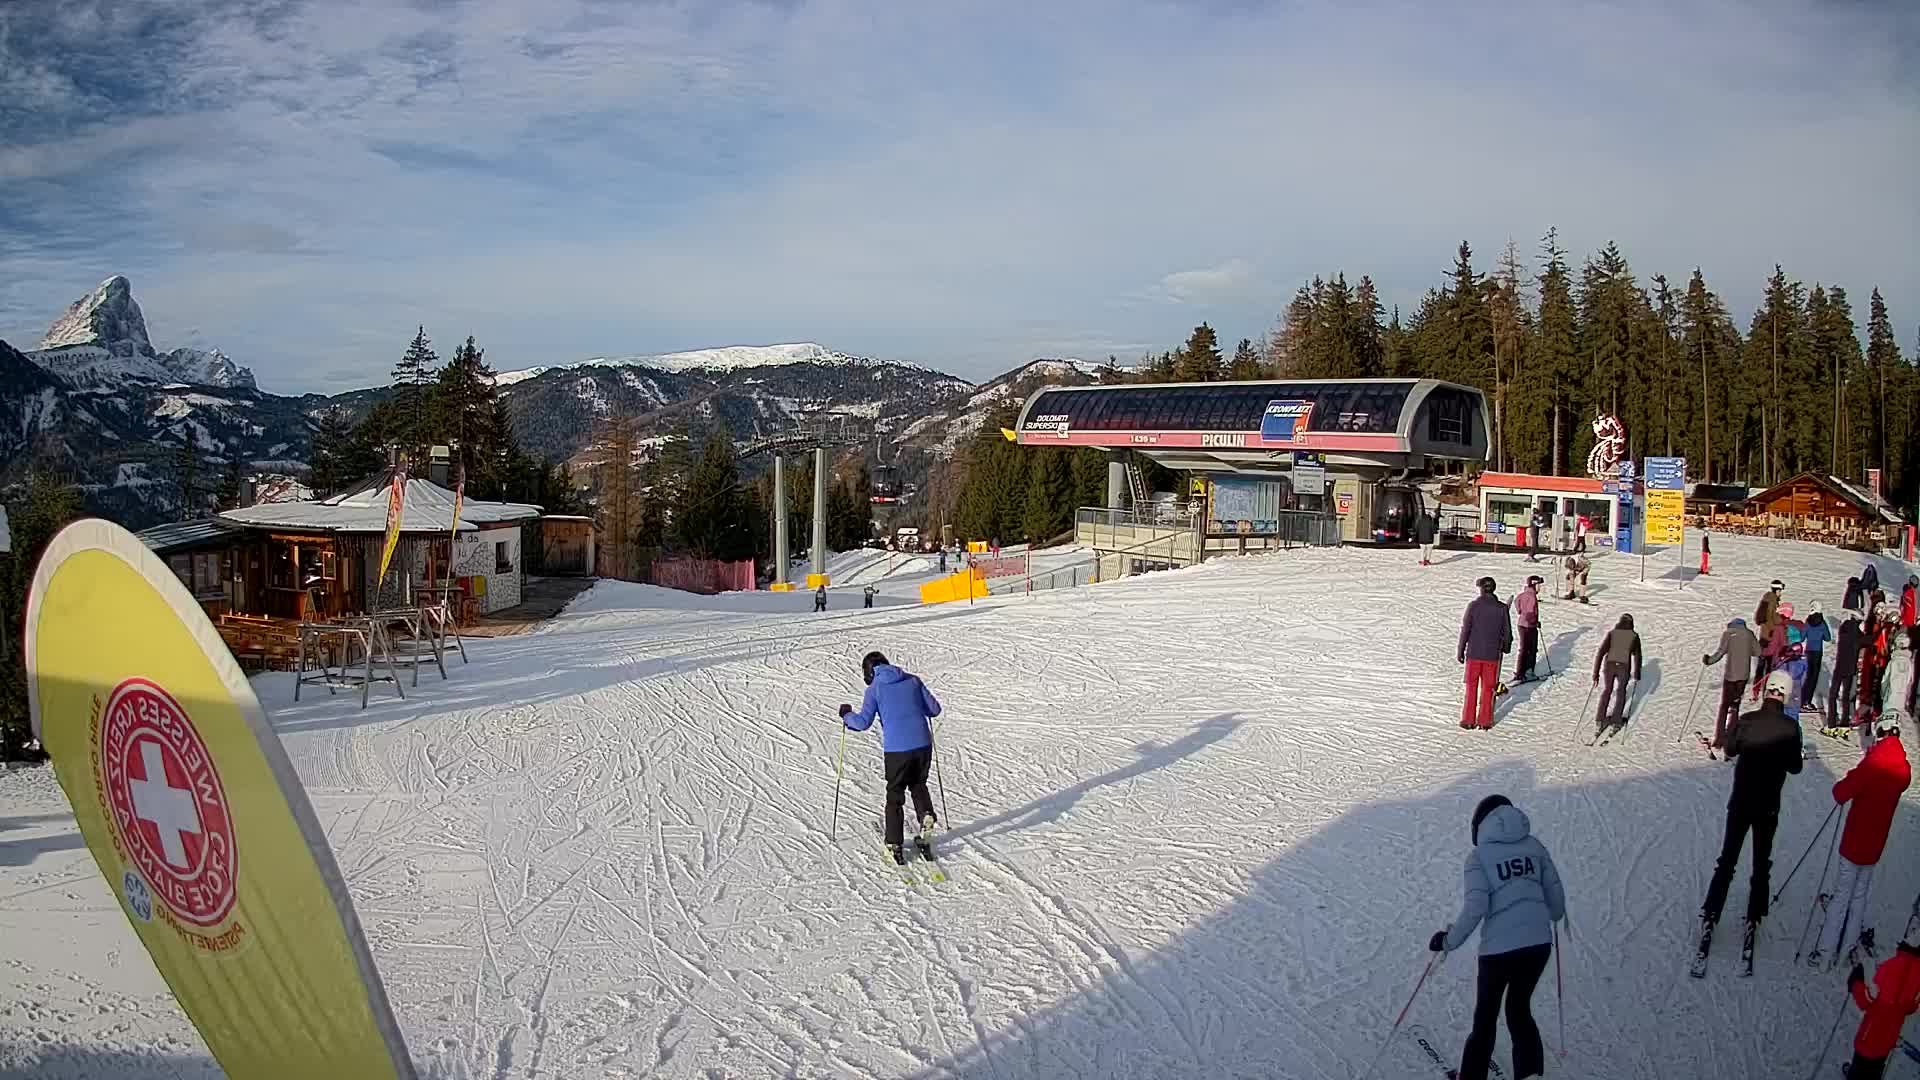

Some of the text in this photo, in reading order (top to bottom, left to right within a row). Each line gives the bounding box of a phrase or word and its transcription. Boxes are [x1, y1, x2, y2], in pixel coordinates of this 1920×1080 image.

[1202, 434, 1245, 447] PICULIN
[1496, 856, 1535, 881] USA
[1417, 1038, 1444, 1064] HEAD
